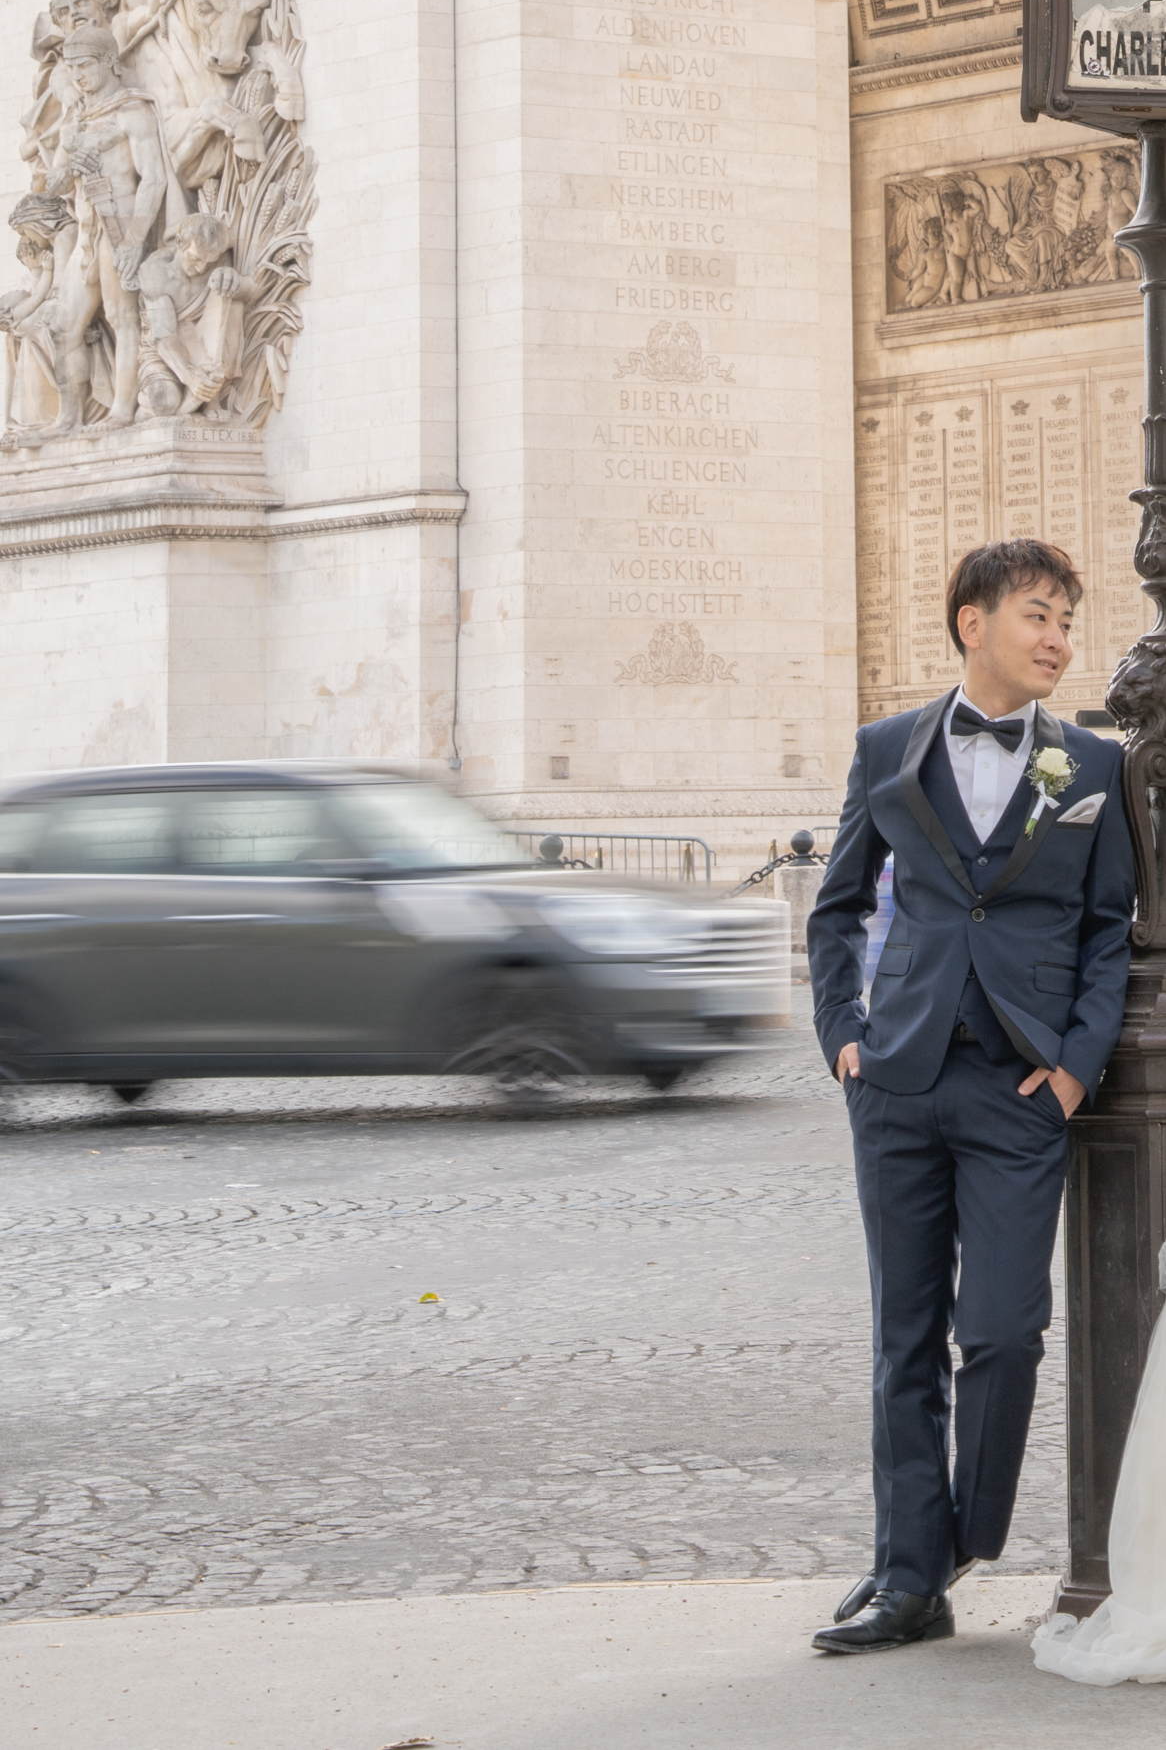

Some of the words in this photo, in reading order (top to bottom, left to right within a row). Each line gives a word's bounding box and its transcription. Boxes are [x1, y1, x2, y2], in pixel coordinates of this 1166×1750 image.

[596, 16, 747, 47] ALDENHOVEN
[625, 51, 716, 78] LANDAU
[625, 118, 719, 145] RASTADT
[617, 151, 727, 178] ETLINGEN
[610, 184, 735, 212] NERESHEIM
[620, 219, 725, 245] BAMBERG
[627, 253, 720, 278] AMBERG
[616, 286, 734, 312] FRIEDBERG
[620, 390, 731, 415] BIBERACH
[1007, 422, 1034, 433] TURREAU
[1044, 417, 1079, 429] DESJARDINS
[178, 430, 197, 440] 1833
[202, 429, 233, 441] ETEX
[592, 424, 759, 450] ALTENKIRCHEN
[1107, 426, 1133, 437] DECOUZ
[914, 434, 936, 444] MOREAU
[1007, 437, 1035, 448] DESSOLES
[1047, 432, 1078, 443] NANSOUTY
[953, 444, 976, 454] MAISON
[1110, 441, 1132, 452] CURIAL
[916, 449, 934, 458] BRUIX
[1012, 452, 1031, 463] BONET
[1050, 447, 1074, 458] DELMAS
[953, 459, 977, 469] MOUTON
[1104, 455, 1138, 467] BEAUMONT
[604, 458, 747, 483] SCHLIENGEN
[912, 463, 938, 473] MICHAUD
[1008, 467, 1035, 478] COMPANS
[1050, 463, 1075, 473] FRIRION
[951, 472, 980, 484] LECOURBE
[1108, 472, 1134, 482] CERVONI
[1005, 481, 1037, 492] MONTBRUN
[1046, 477, 1079, 489] CLAPAREDE
[920, 493, 932, 502] NEY
[956, 488, 981, 498] SUZANNE
[1052, 493, 1074, 503] BISSON
[647, 494, 705, 516] KEHL
[955, 503, 977, 513] FERINO
[1109, 502, 1134, 513] LASALLE
[909, 507, 942, 517] MACDONALD
[1050, 507, 1076, 518] WALTHER
[914, 521, 938, 532] OUDINOT
[1050, 522, 1076, 533] BRUYERE
[1108, 517, 1136, 528] DURUTTE
[1010, 527, 1035, 537] MORAND
[637, 527, 715, 549] ENGEN
[914, 537, 938, 547] DAVOUST
[1113, 533, 1131, 543] KLEIN
[915, 551, 938, 561] LANNES
[609, 559, 743, 582] MOESKIRCH
[914, 565, 939, 575] MORTIER
[913, 579, 941, 589] BESSIERES
[608, 592, 743, 614] HOCHSTETT
[918, 608, 936, 617] ROSILY
[1109, 604, 1140, 615] FRESSINET
[912, 621, 943, 632] LAURISTON
[1111, 619, 1137, 629] DEMONT
[911, 635, 943, 646] VILLENEUVE
[915, 650, 940, 659] MOLITOR
[936, 666, 960, 676] MOREAUX
[1057, 690, 1076, 700] ALPES
